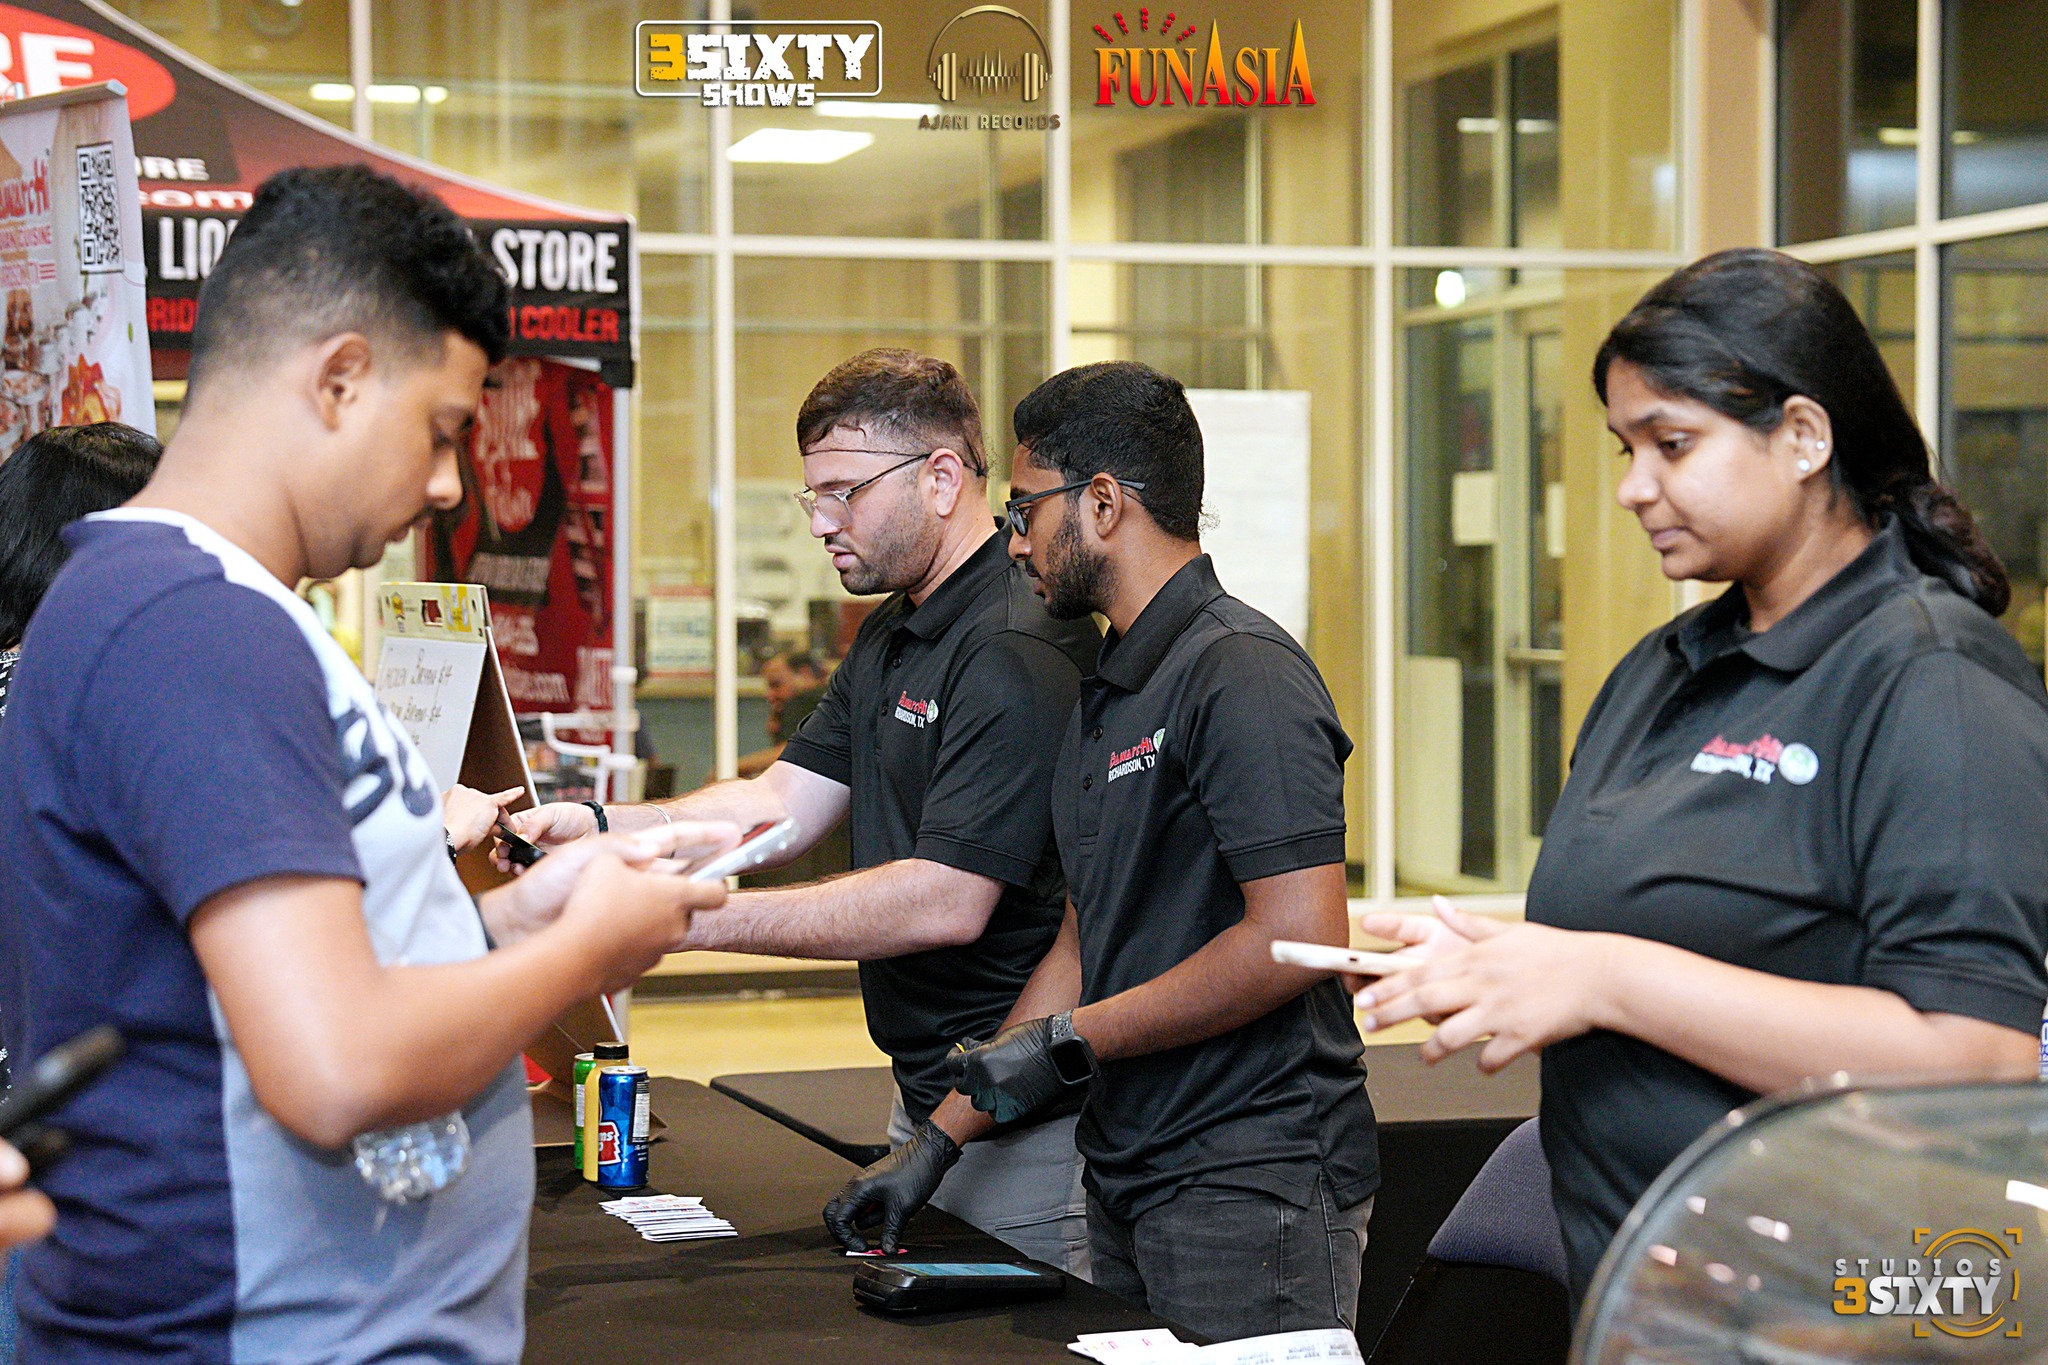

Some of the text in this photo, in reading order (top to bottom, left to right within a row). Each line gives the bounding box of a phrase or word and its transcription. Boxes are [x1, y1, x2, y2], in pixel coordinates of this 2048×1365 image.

[491, 228, 619, 293] STORE
[520, 305, 619, 342] COOLER
[1107, 753, 1156, 783] RICHARDSON, TX
